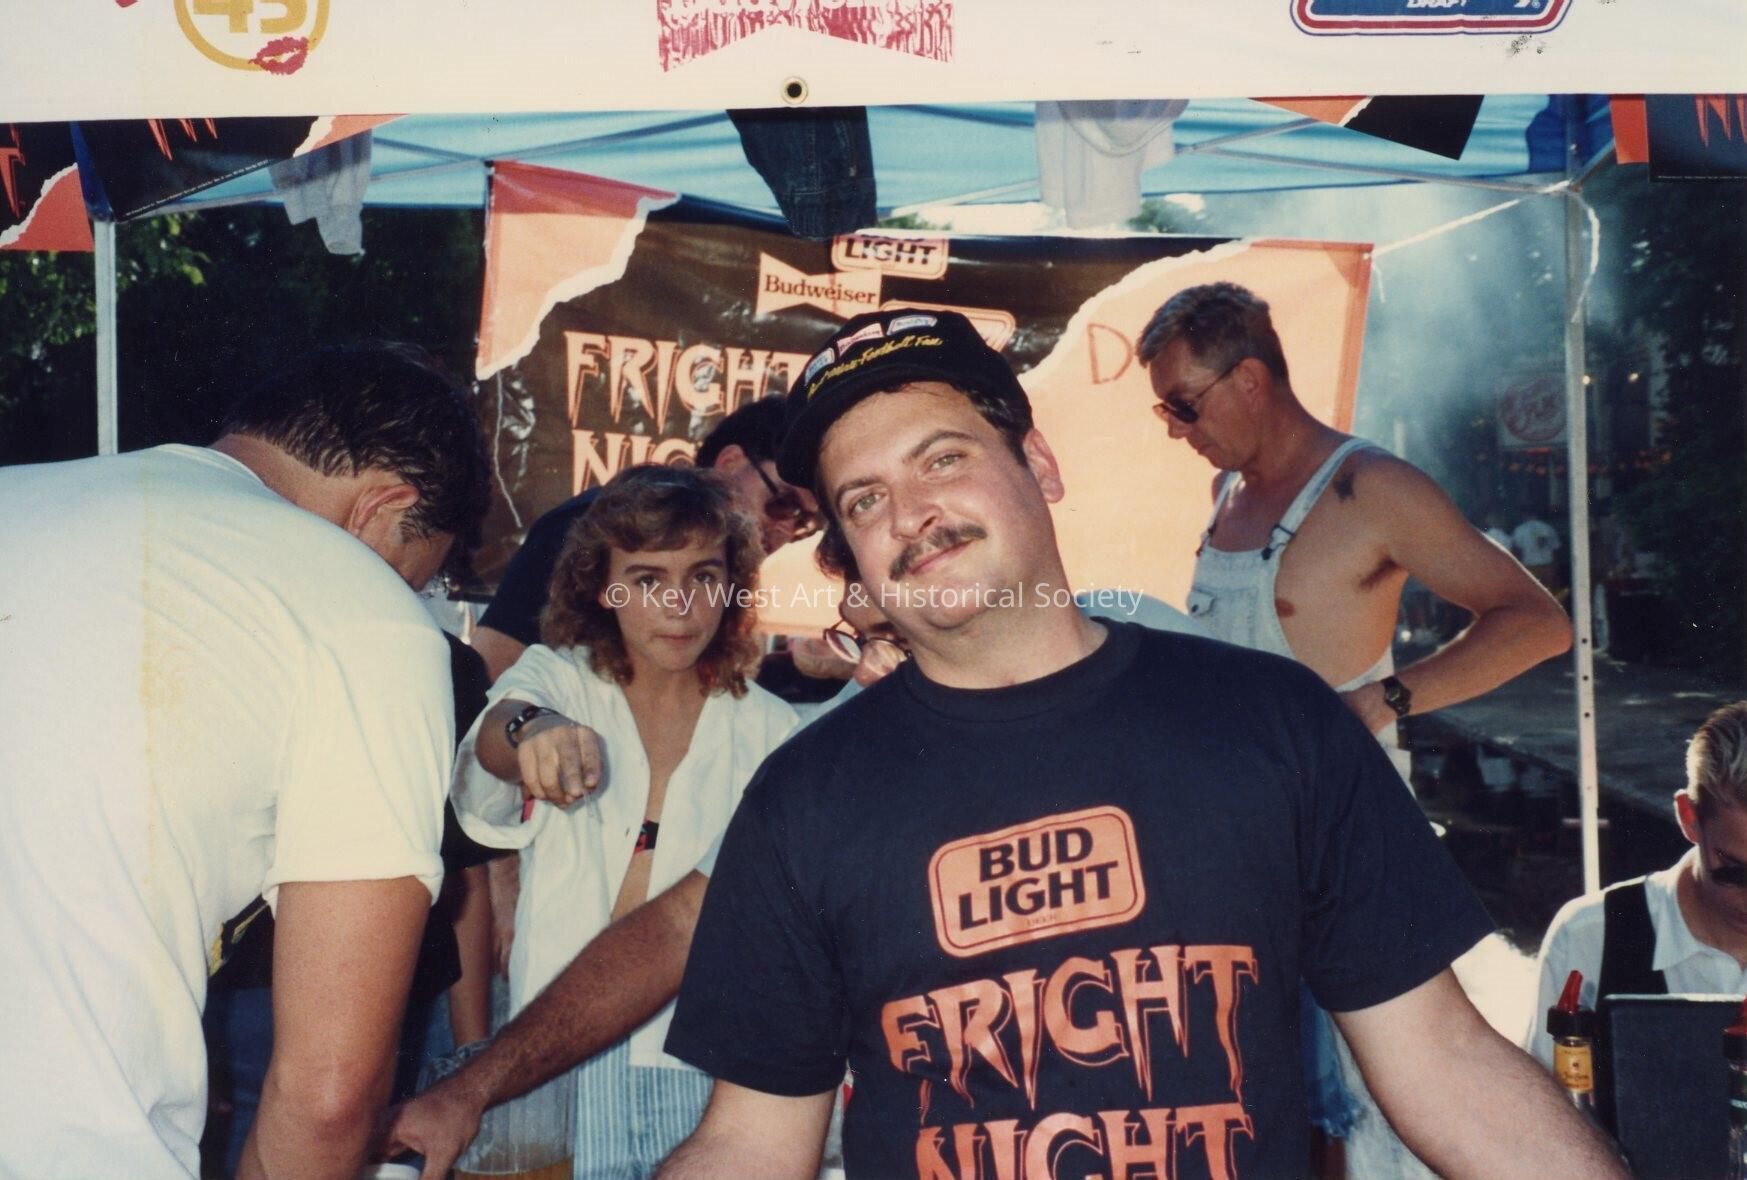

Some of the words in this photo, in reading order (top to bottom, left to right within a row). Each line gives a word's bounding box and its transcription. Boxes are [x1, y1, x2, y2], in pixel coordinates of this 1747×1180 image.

[844, 238, 937, 265] LIGHT
[764, 274, 876, 304] Budweiser
[978, 827, 1093, 883] BUD
[958, 860, 1118, 931] LIGHT
[881, 944, 1259, 1124] FRIGHT
